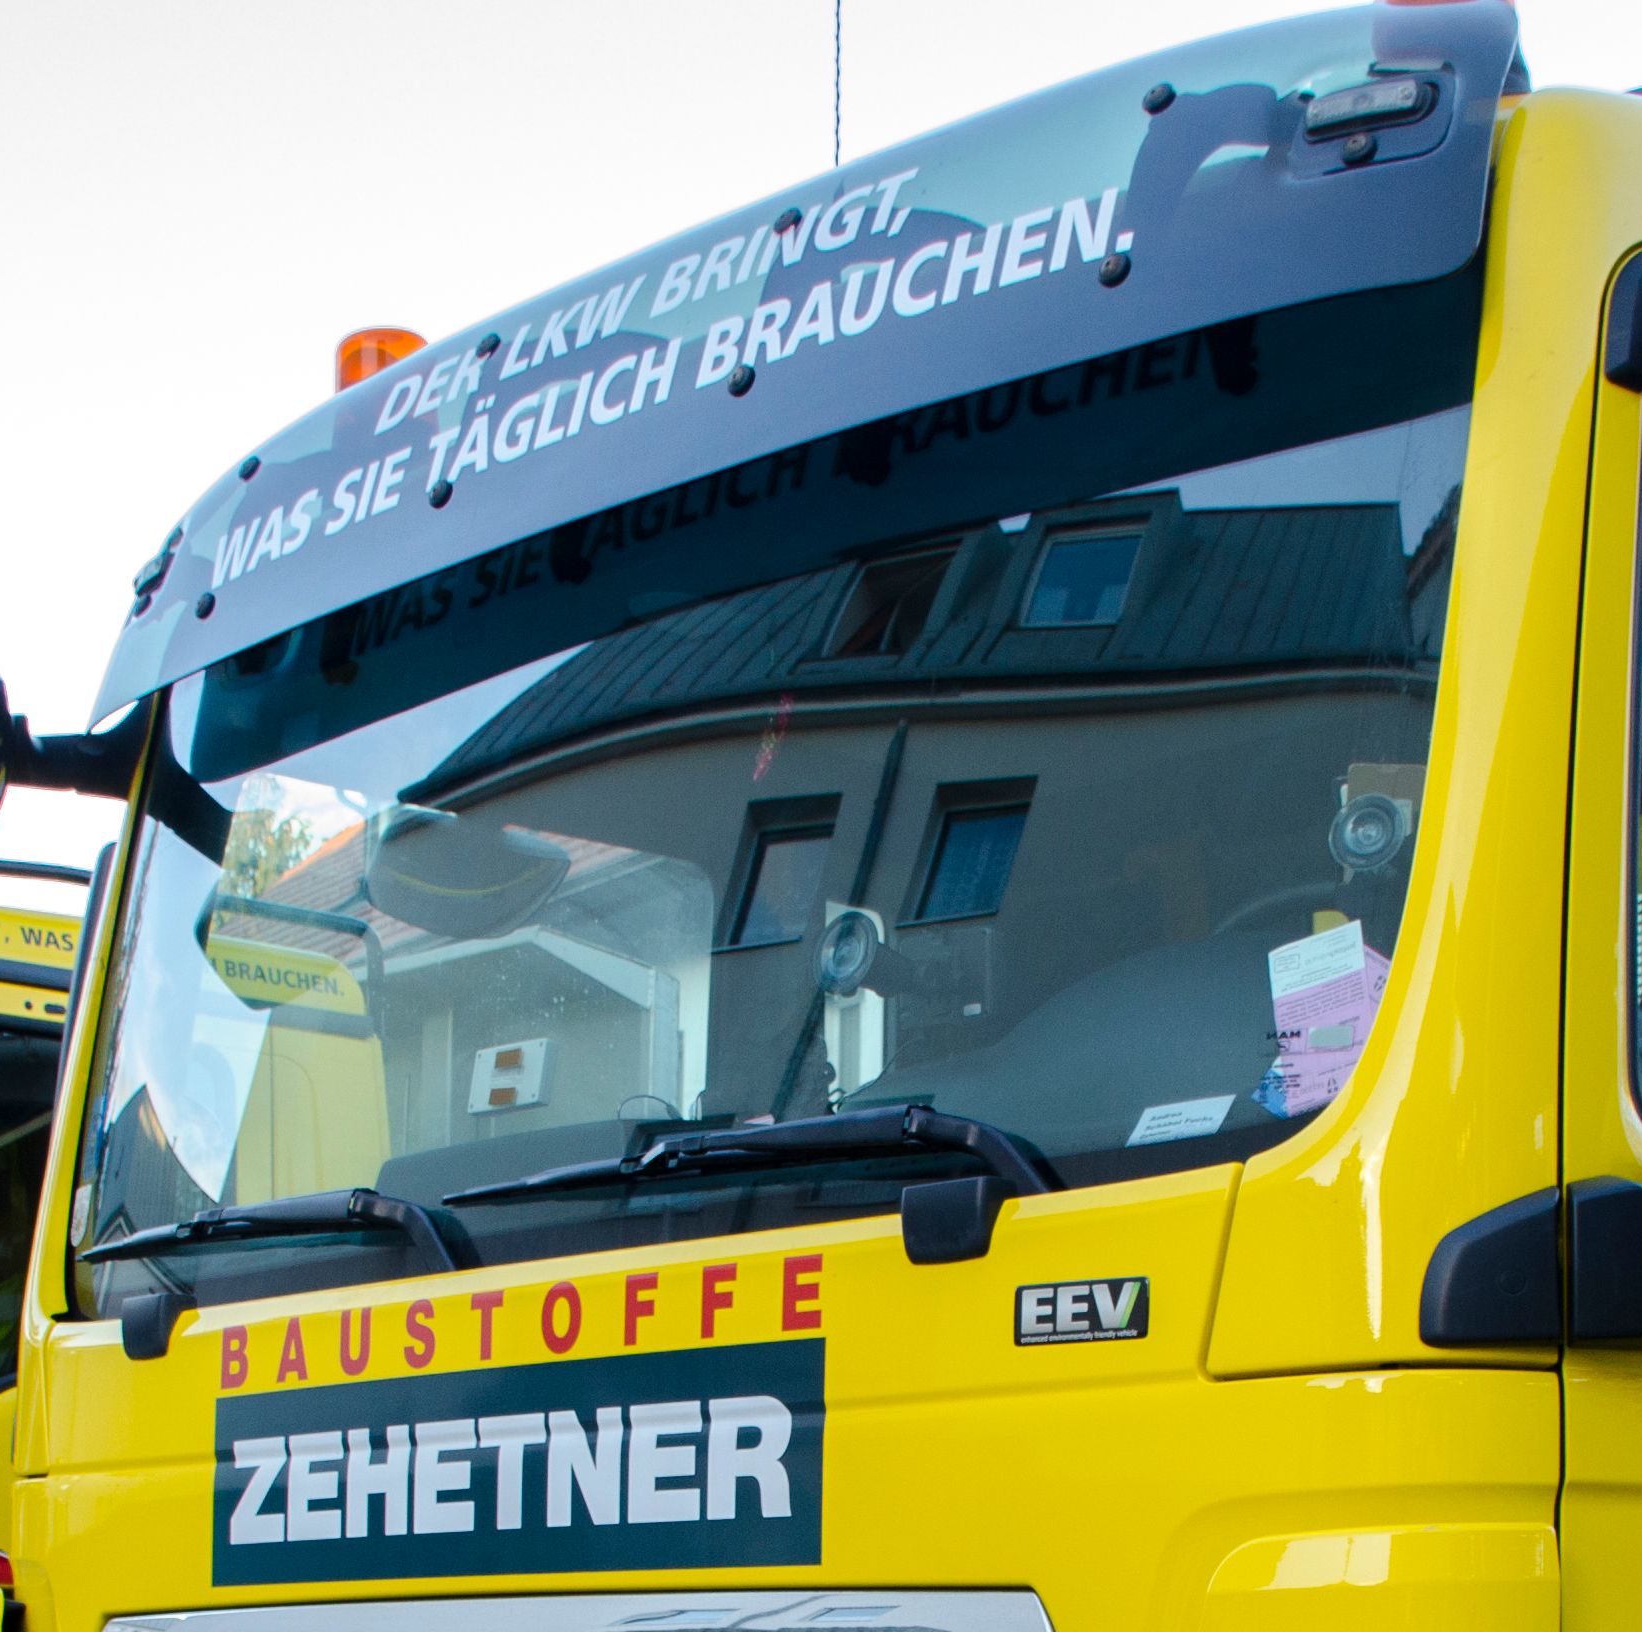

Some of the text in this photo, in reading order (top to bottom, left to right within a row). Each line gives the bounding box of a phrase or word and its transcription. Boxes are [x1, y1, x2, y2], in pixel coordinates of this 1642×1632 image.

[373, 167, 920, 437] DER LKW BRINGT,
[210, 186, 1135, 590] WAS SIE TÄGLICH BRAUCHEN.
[20, 926, 75, 952] WAS
[220, 1253, 825, 1391] BAUSTOFFE
[1021, 1281, 1141, 1335] EEV
[229, 1393, 792, 1546] ZEHETNER
